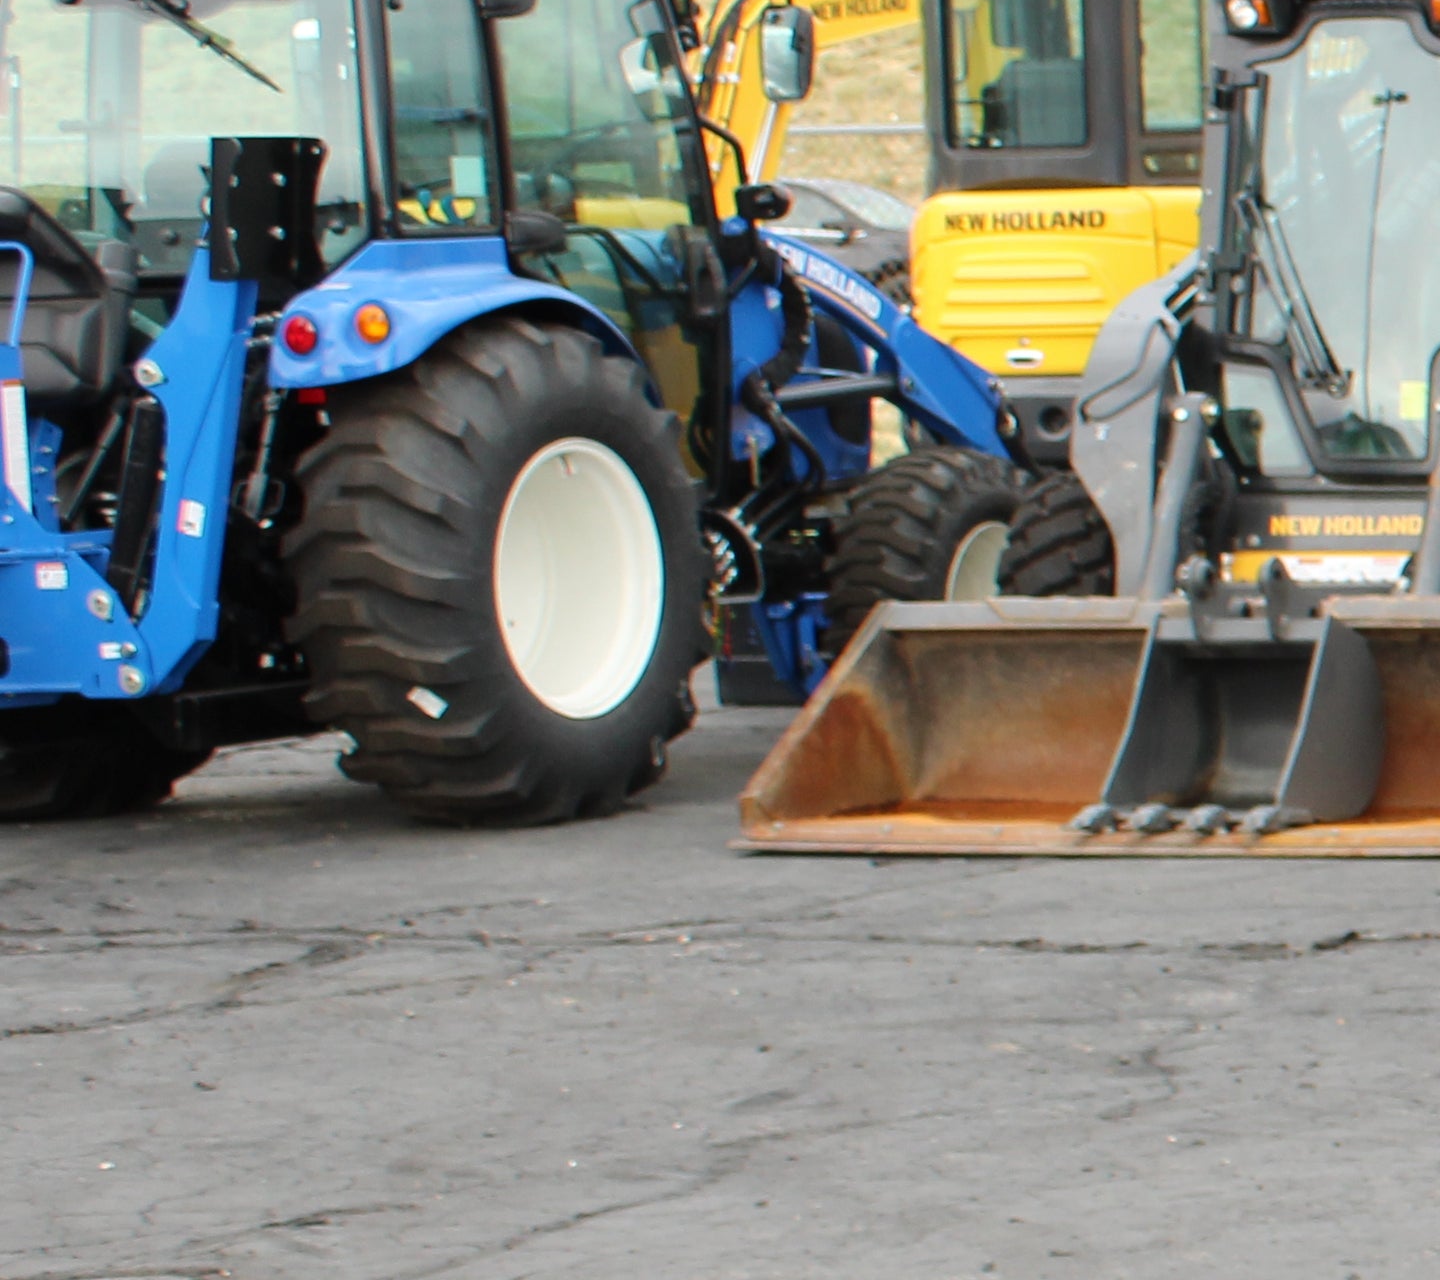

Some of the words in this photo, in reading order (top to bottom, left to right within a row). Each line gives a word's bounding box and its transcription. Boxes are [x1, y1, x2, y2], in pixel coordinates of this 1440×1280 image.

[945, 212, 984, 231] NEW
[992, 210, 1106, 231] HOLLAND
[1270, 515, 1321, 536] NEW
[1323, 514, 1425, 536] HOLLAND
